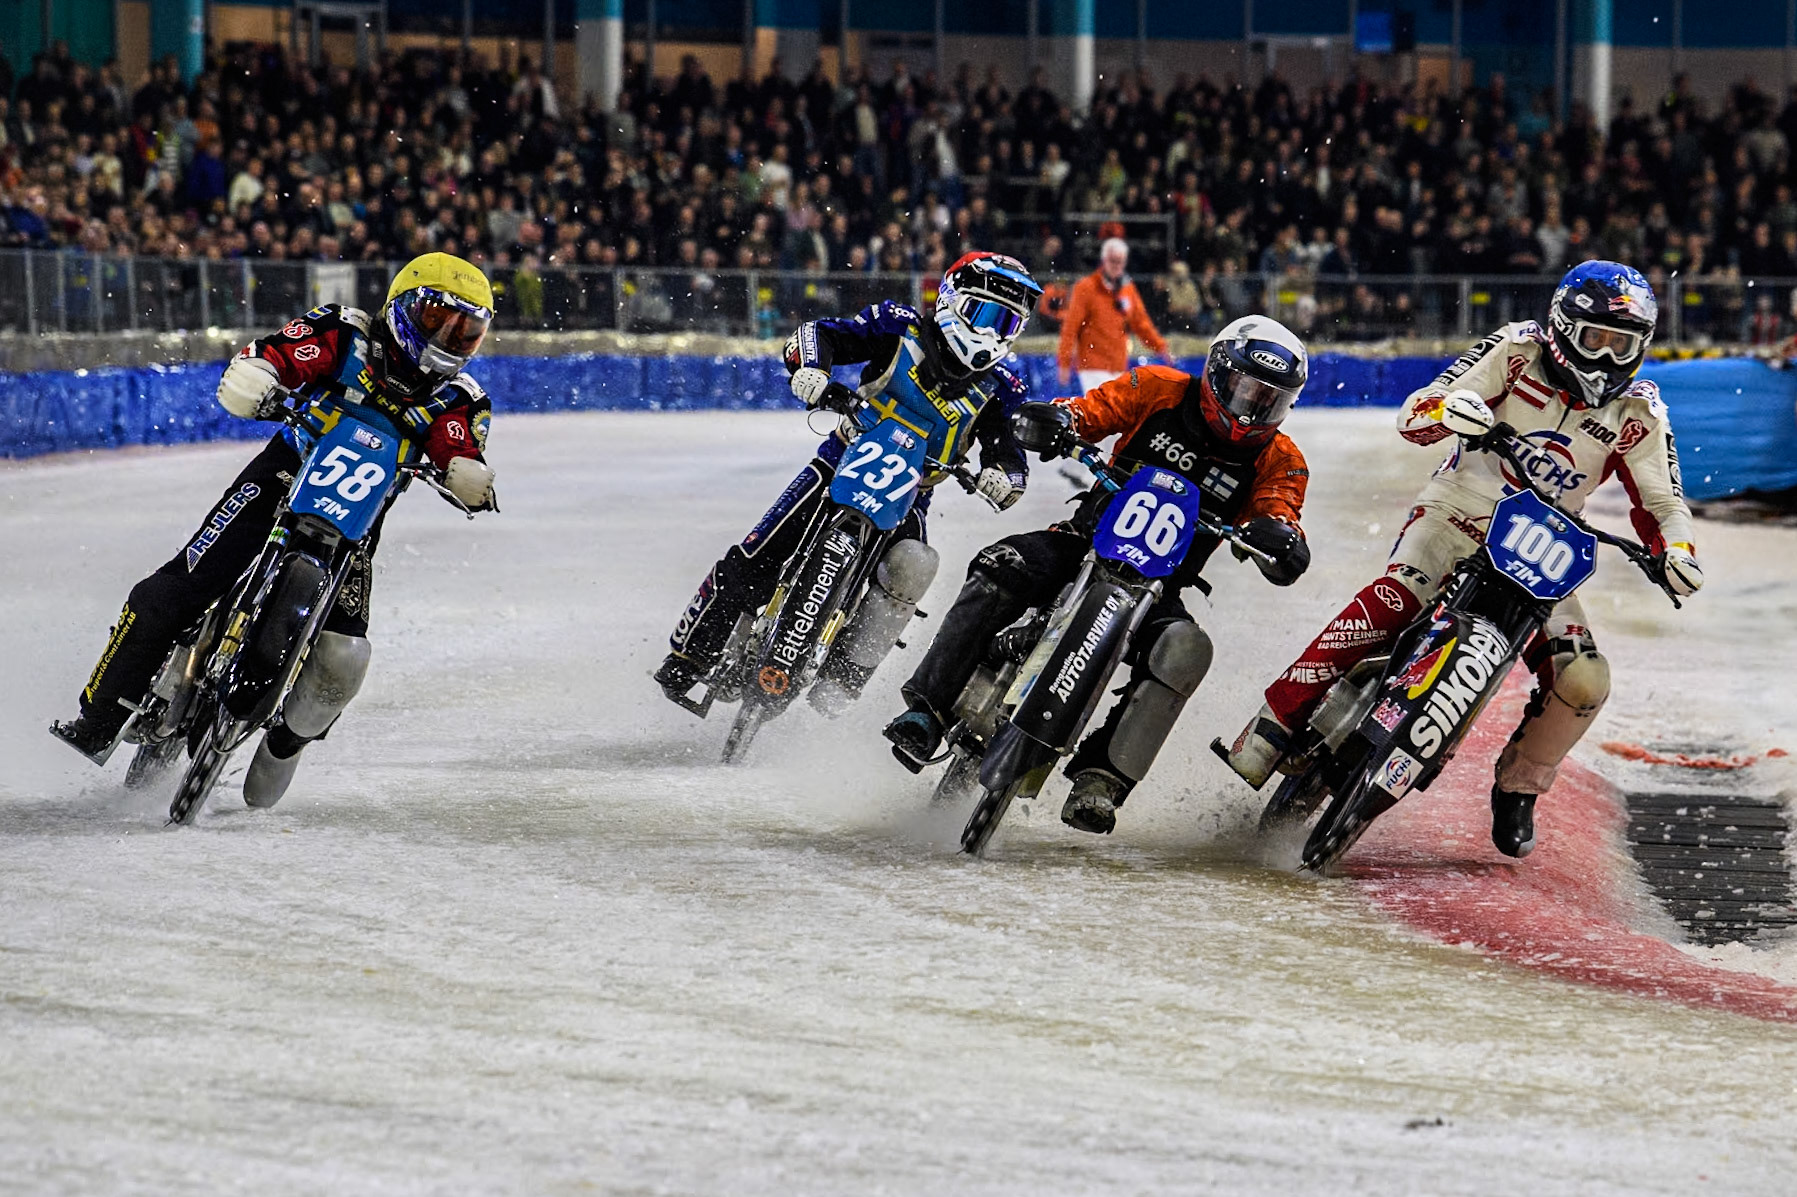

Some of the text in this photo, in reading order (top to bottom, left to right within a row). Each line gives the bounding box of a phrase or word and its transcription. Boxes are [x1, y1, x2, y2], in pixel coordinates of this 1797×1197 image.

[1253, 351, 1287, 370] HJC
[907, 365, 960, 427] SEDEN
[1580, 418, 1617, 444] #100
[1149, 432, 1197, 471] #66
[308, 445, 386, 502] 58
[838, 441, 921, 502] 237
[191, 482, 261, 557] REJLERS
[313, 496, 350, 521] FIM
[852, 490, 884, 514] FIM
[1113, 491, 1186, 557] 66
[1116, 543, 1151, 566] FIM
[1500, 514, 1575, 583] 100
[1505, 559, 1543, 588] FIM
[1056, 594, 1121, 705] AUTOTARVIKE OY
[1289, 666, 1345, 684] MIESL
[1386, 756, 1412, 790] FUCHS
